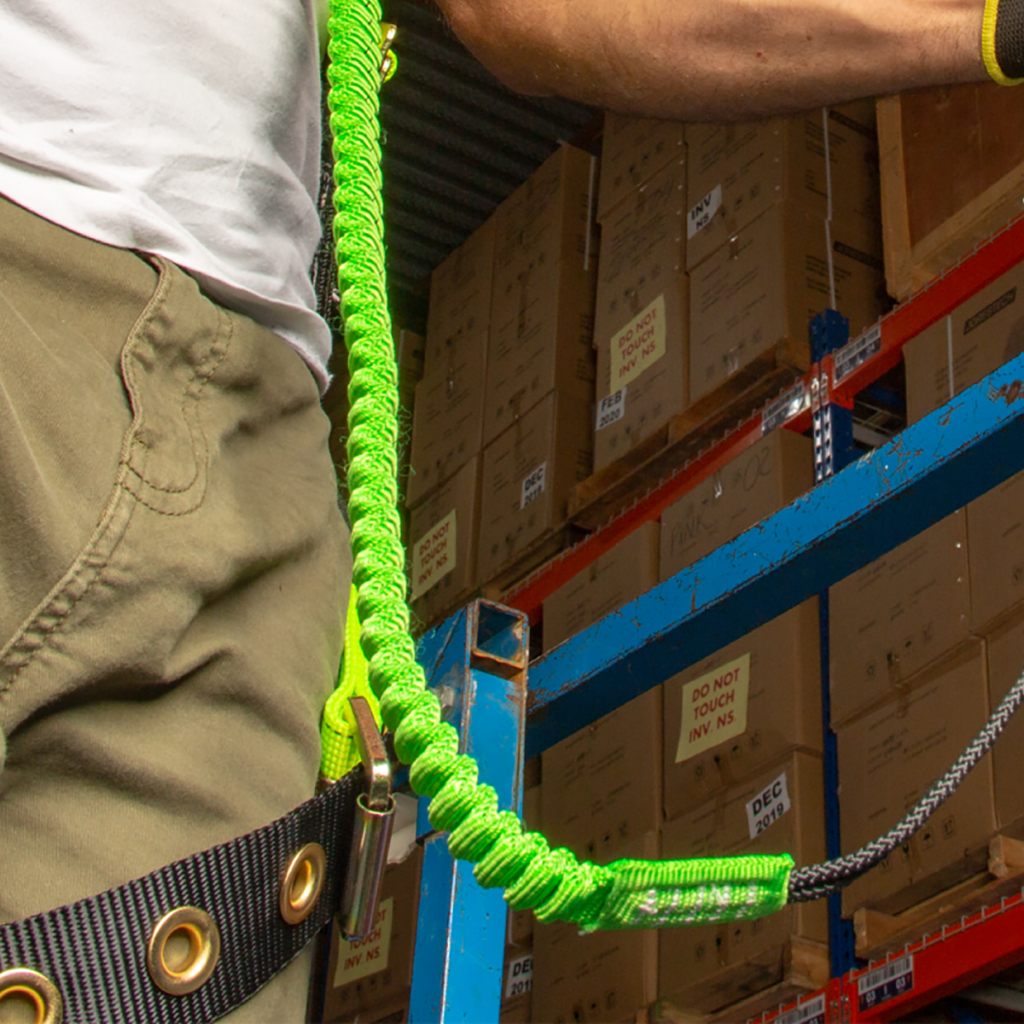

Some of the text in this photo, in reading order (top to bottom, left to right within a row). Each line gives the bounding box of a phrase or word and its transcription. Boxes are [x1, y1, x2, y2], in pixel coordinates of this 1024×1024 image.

[691, 193, 711, 220] INV
[619, 308, 657, 349] DO NOT
[622, 325, 655, 359] TOUCH
[601, 389, 622, 412] FEB
[525, 467, 543, 492] DEC
[419, 521, 451, 557] DO NOT
[421, 538, 447, 567] TOUCH
[691, 667, 740, 704] DO NOT
[693, 689, 735, 721] TOUCH
[752, 780, 783, 816] DEC
[754, 802, 784, 835] 2019
[512, 958, 533, 977] DE
[865, 992, 876, 1003] 03
[895, 977, 907, 990] 03
